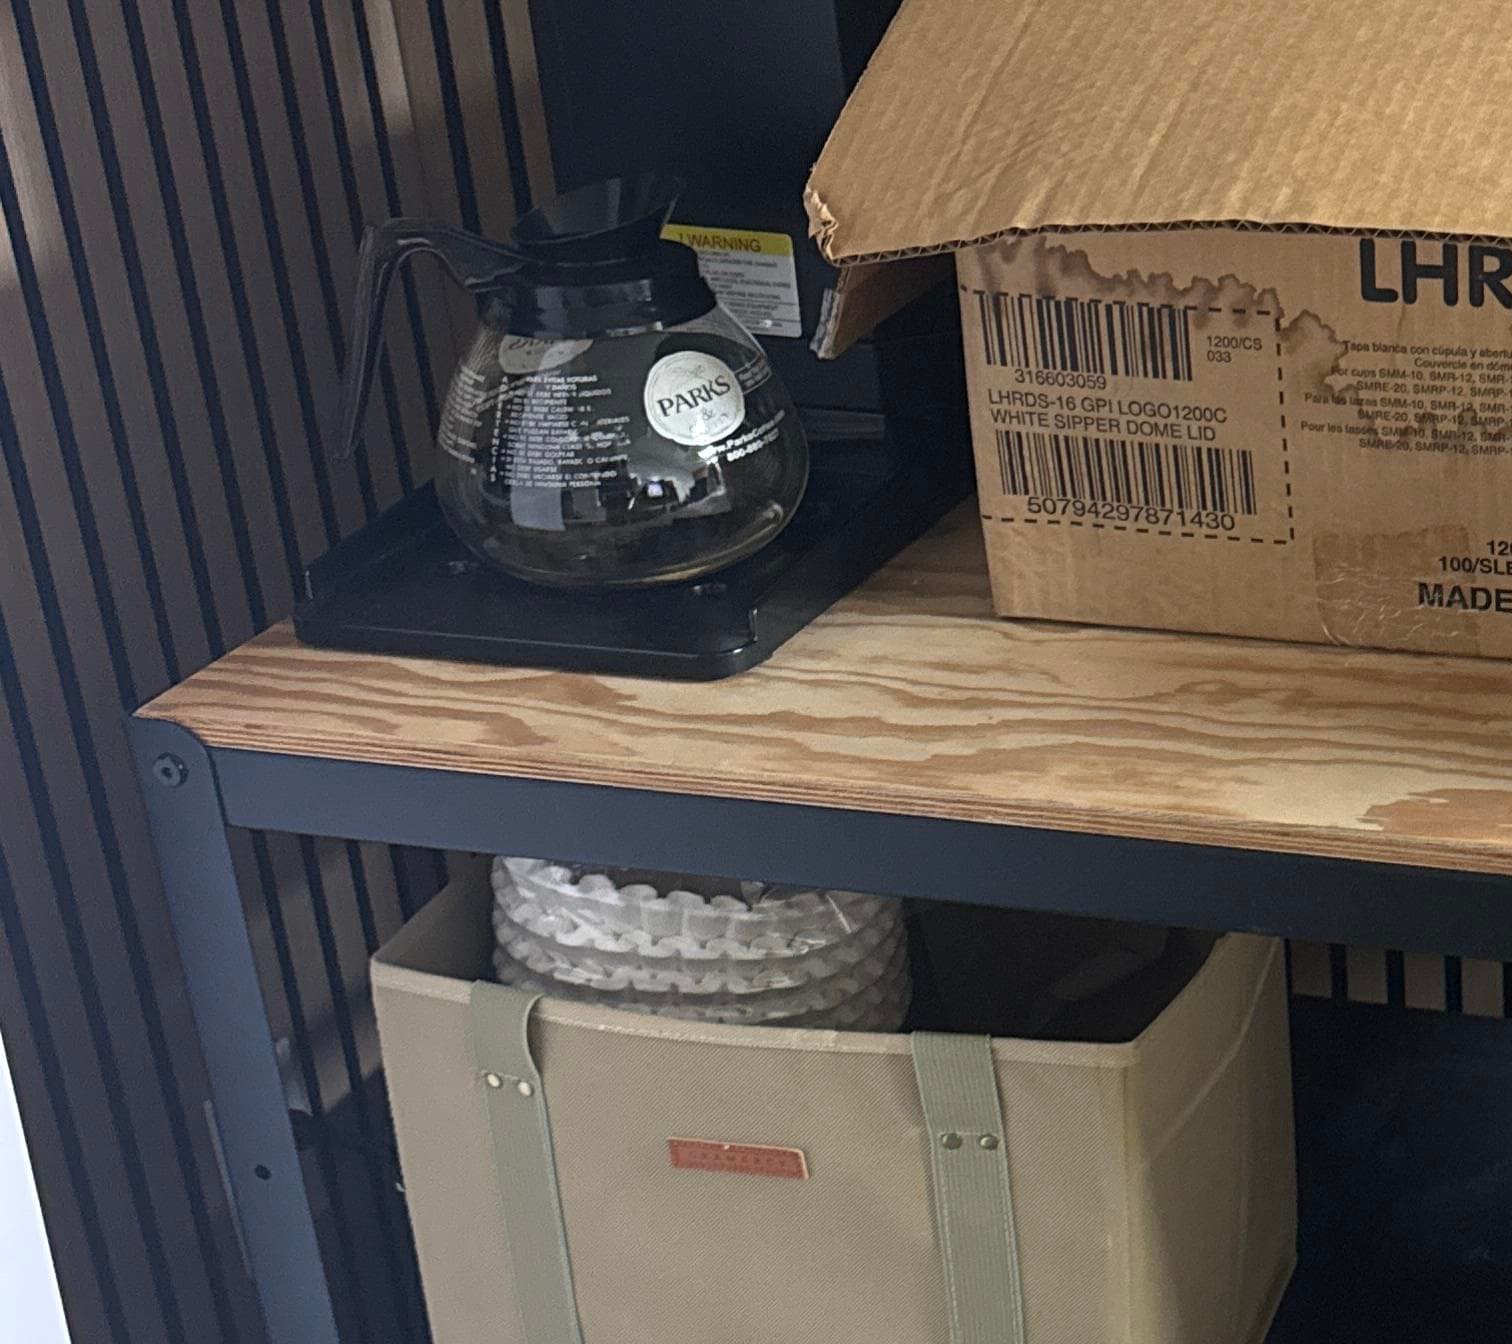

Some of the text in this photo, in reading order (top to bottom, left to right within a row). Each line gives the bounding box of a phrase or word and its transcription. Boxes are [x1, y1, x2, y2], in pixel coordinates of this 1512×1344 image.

[687, 234, 761, 252] WARNING
[1206, 336, 1262, 351] 1200/CS
[1372, 342, 1407, 353] blanca
[1410, 345, 1429, 354] con
[1206, 351, 1232, 363] 033
[1470, 362, 1484, 370] en
[1015, 368, 1107, 390] 316603059
[657, 375, 730, 416] PARKS
[988, 389, 1228, 424] LHRDS-16 GPI LOGO1200C
[990, 408, 1216, 441] WHITE SIPPER DOME LID
[1301, 420, 1324, 432] Pour
[1027, 497, 1235, 531] 50794297871430
